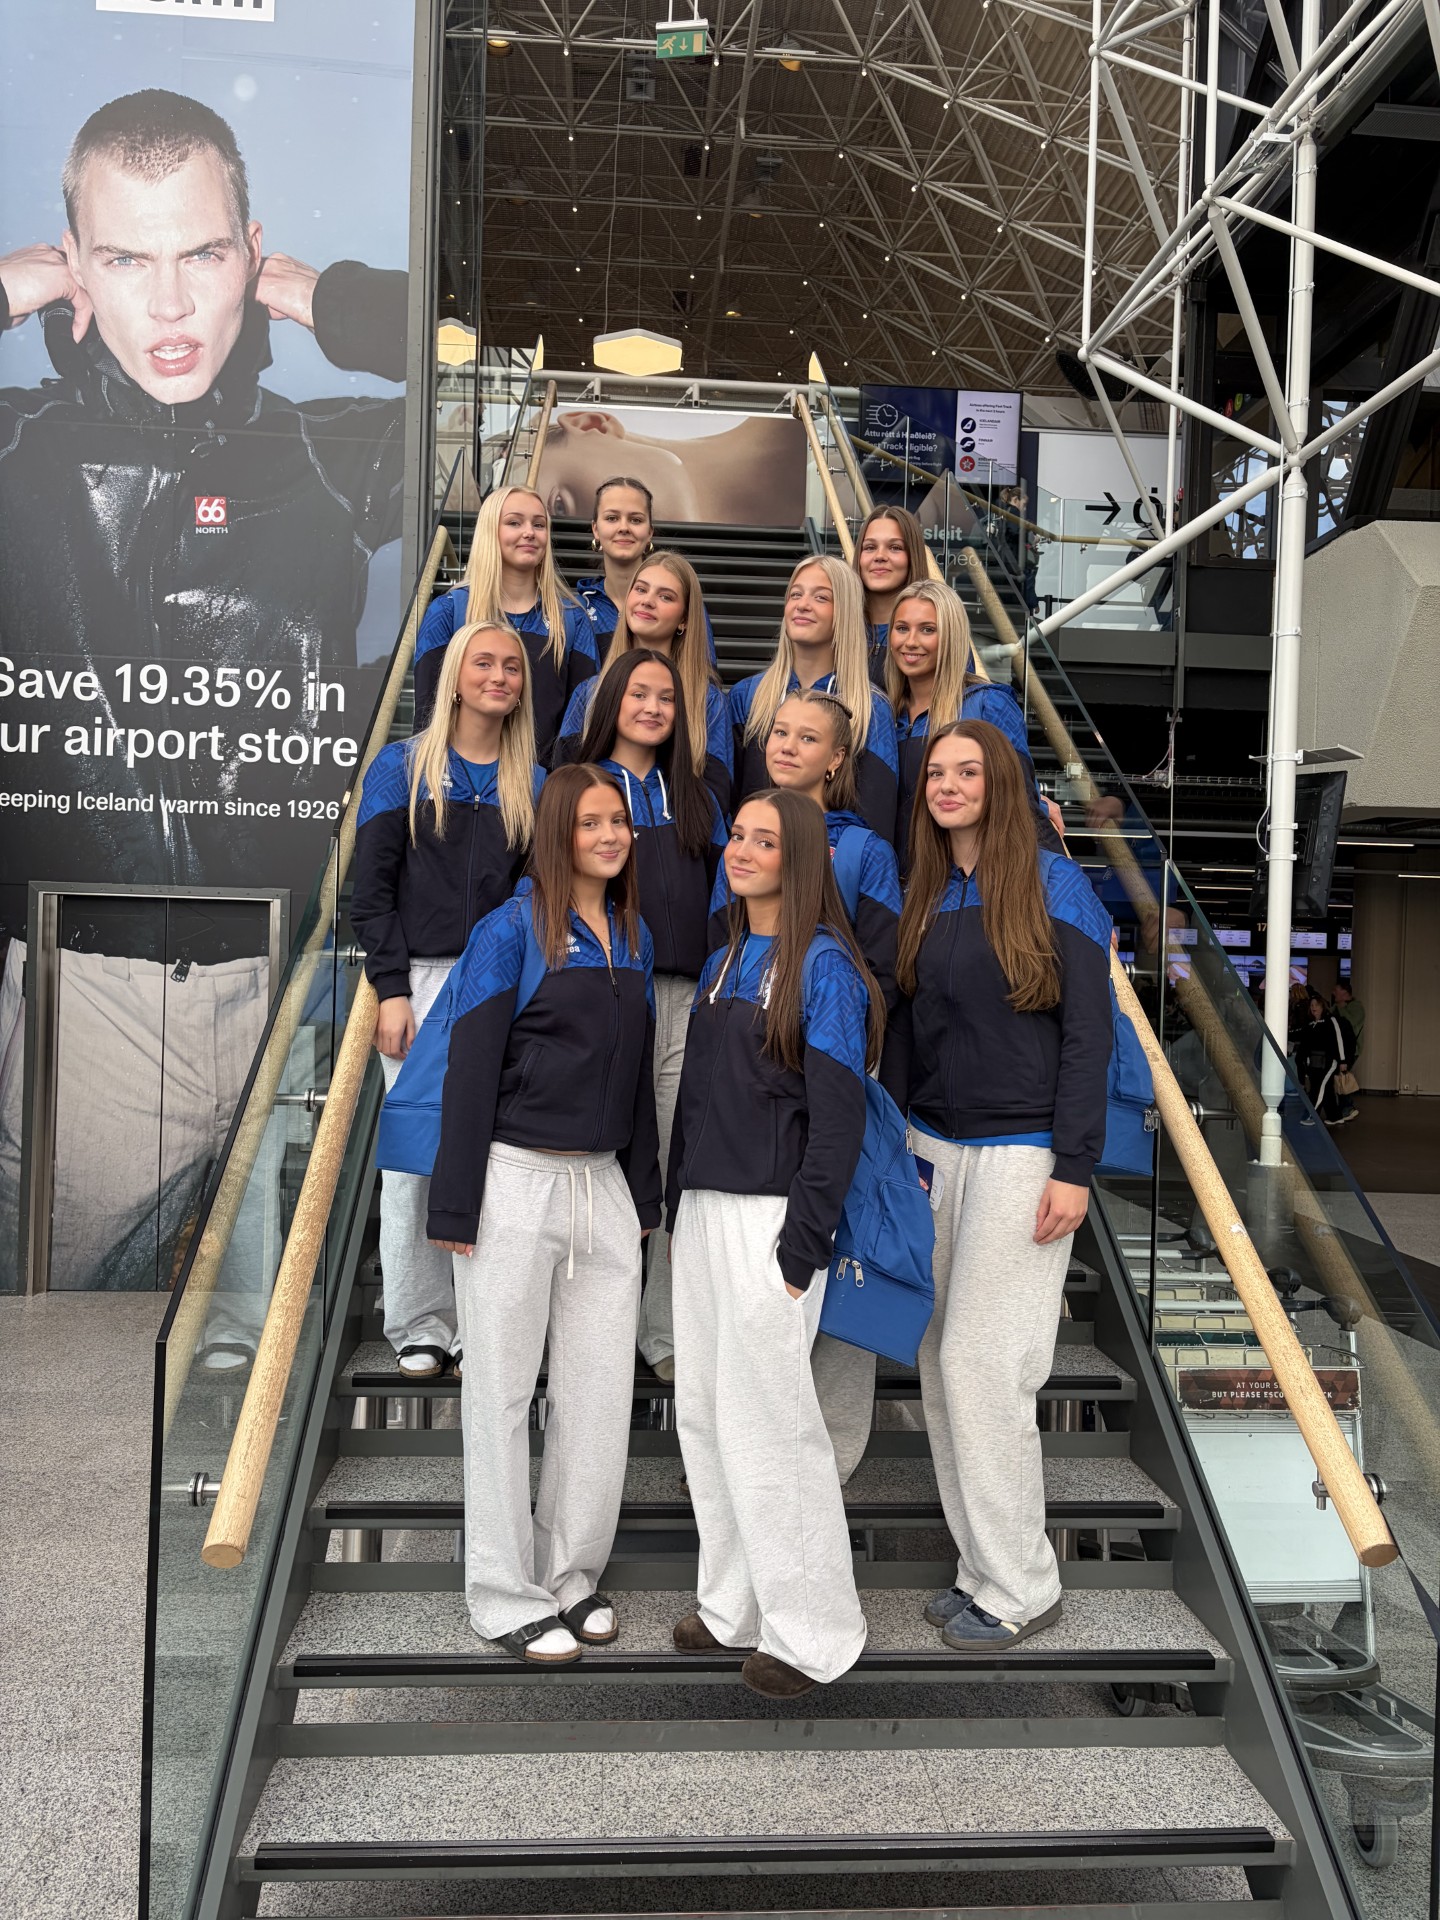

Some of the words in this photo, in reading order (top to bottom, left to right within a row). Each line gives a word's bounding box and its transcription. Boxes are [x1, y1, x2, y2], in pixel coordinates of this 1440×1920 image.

[882, 441, 904, 450] Track
[195, 526, 229, 534] NORTH
[921, 524, 963, 541] sleit
[936, 549, 983, 567] chec
[0, 656, 100, 700] Save
[116, 663, 291, 710] 19.35%
[307, 672, 345, 712] in
[0, 723, 50, 753] ur
[64, 716, 225, 769] airport
[238, 727, 358, 767] store
[0, 789, 70, 814] eeping
[77, 791, 154, 812] Iceland
[160, 799, 219, 815] warm
[224, 799, 281, 818] since
[288, 800, 340, 820] 1926
